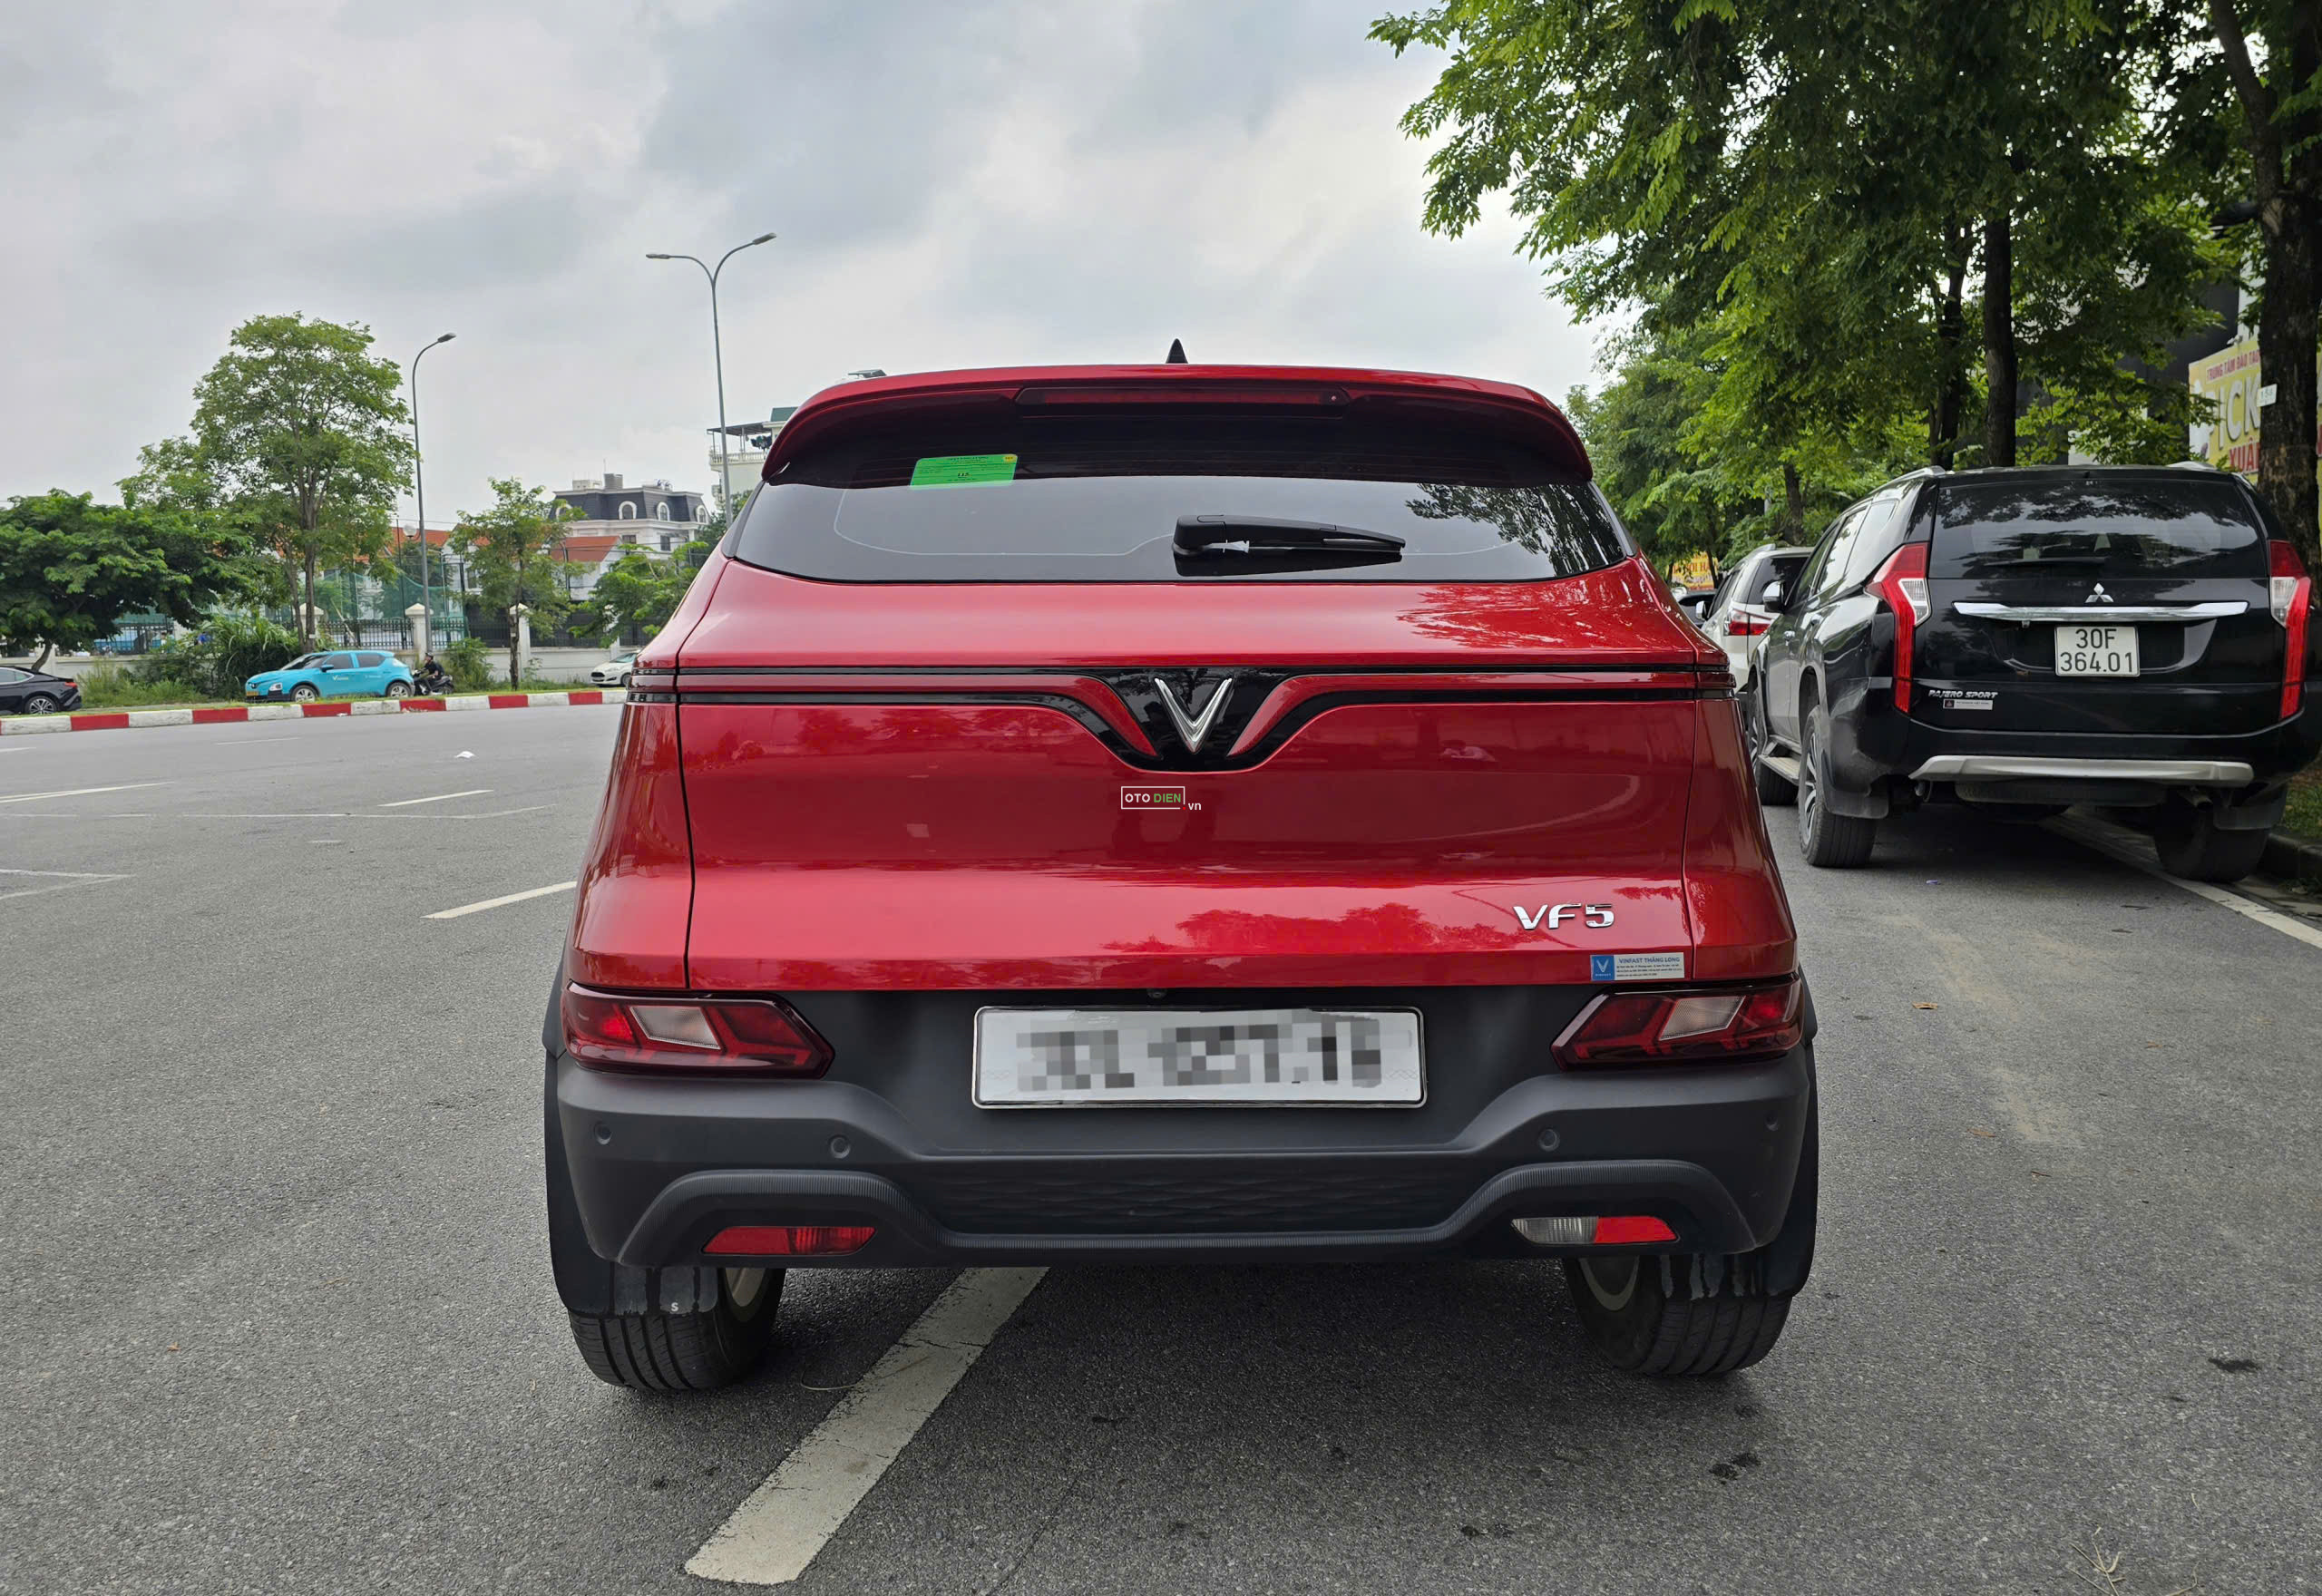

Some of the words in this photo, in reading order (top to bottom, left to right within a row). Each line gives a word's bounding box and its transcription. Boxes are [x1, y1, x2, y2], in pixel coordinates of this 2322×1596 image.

[2075, 628, 2117, 649] 30F
[2060, 651, 2133, 673] 364.01
[1928, 689, 1964, 698] PAJERO
[1965, 691, 1998, 699] SPORT
